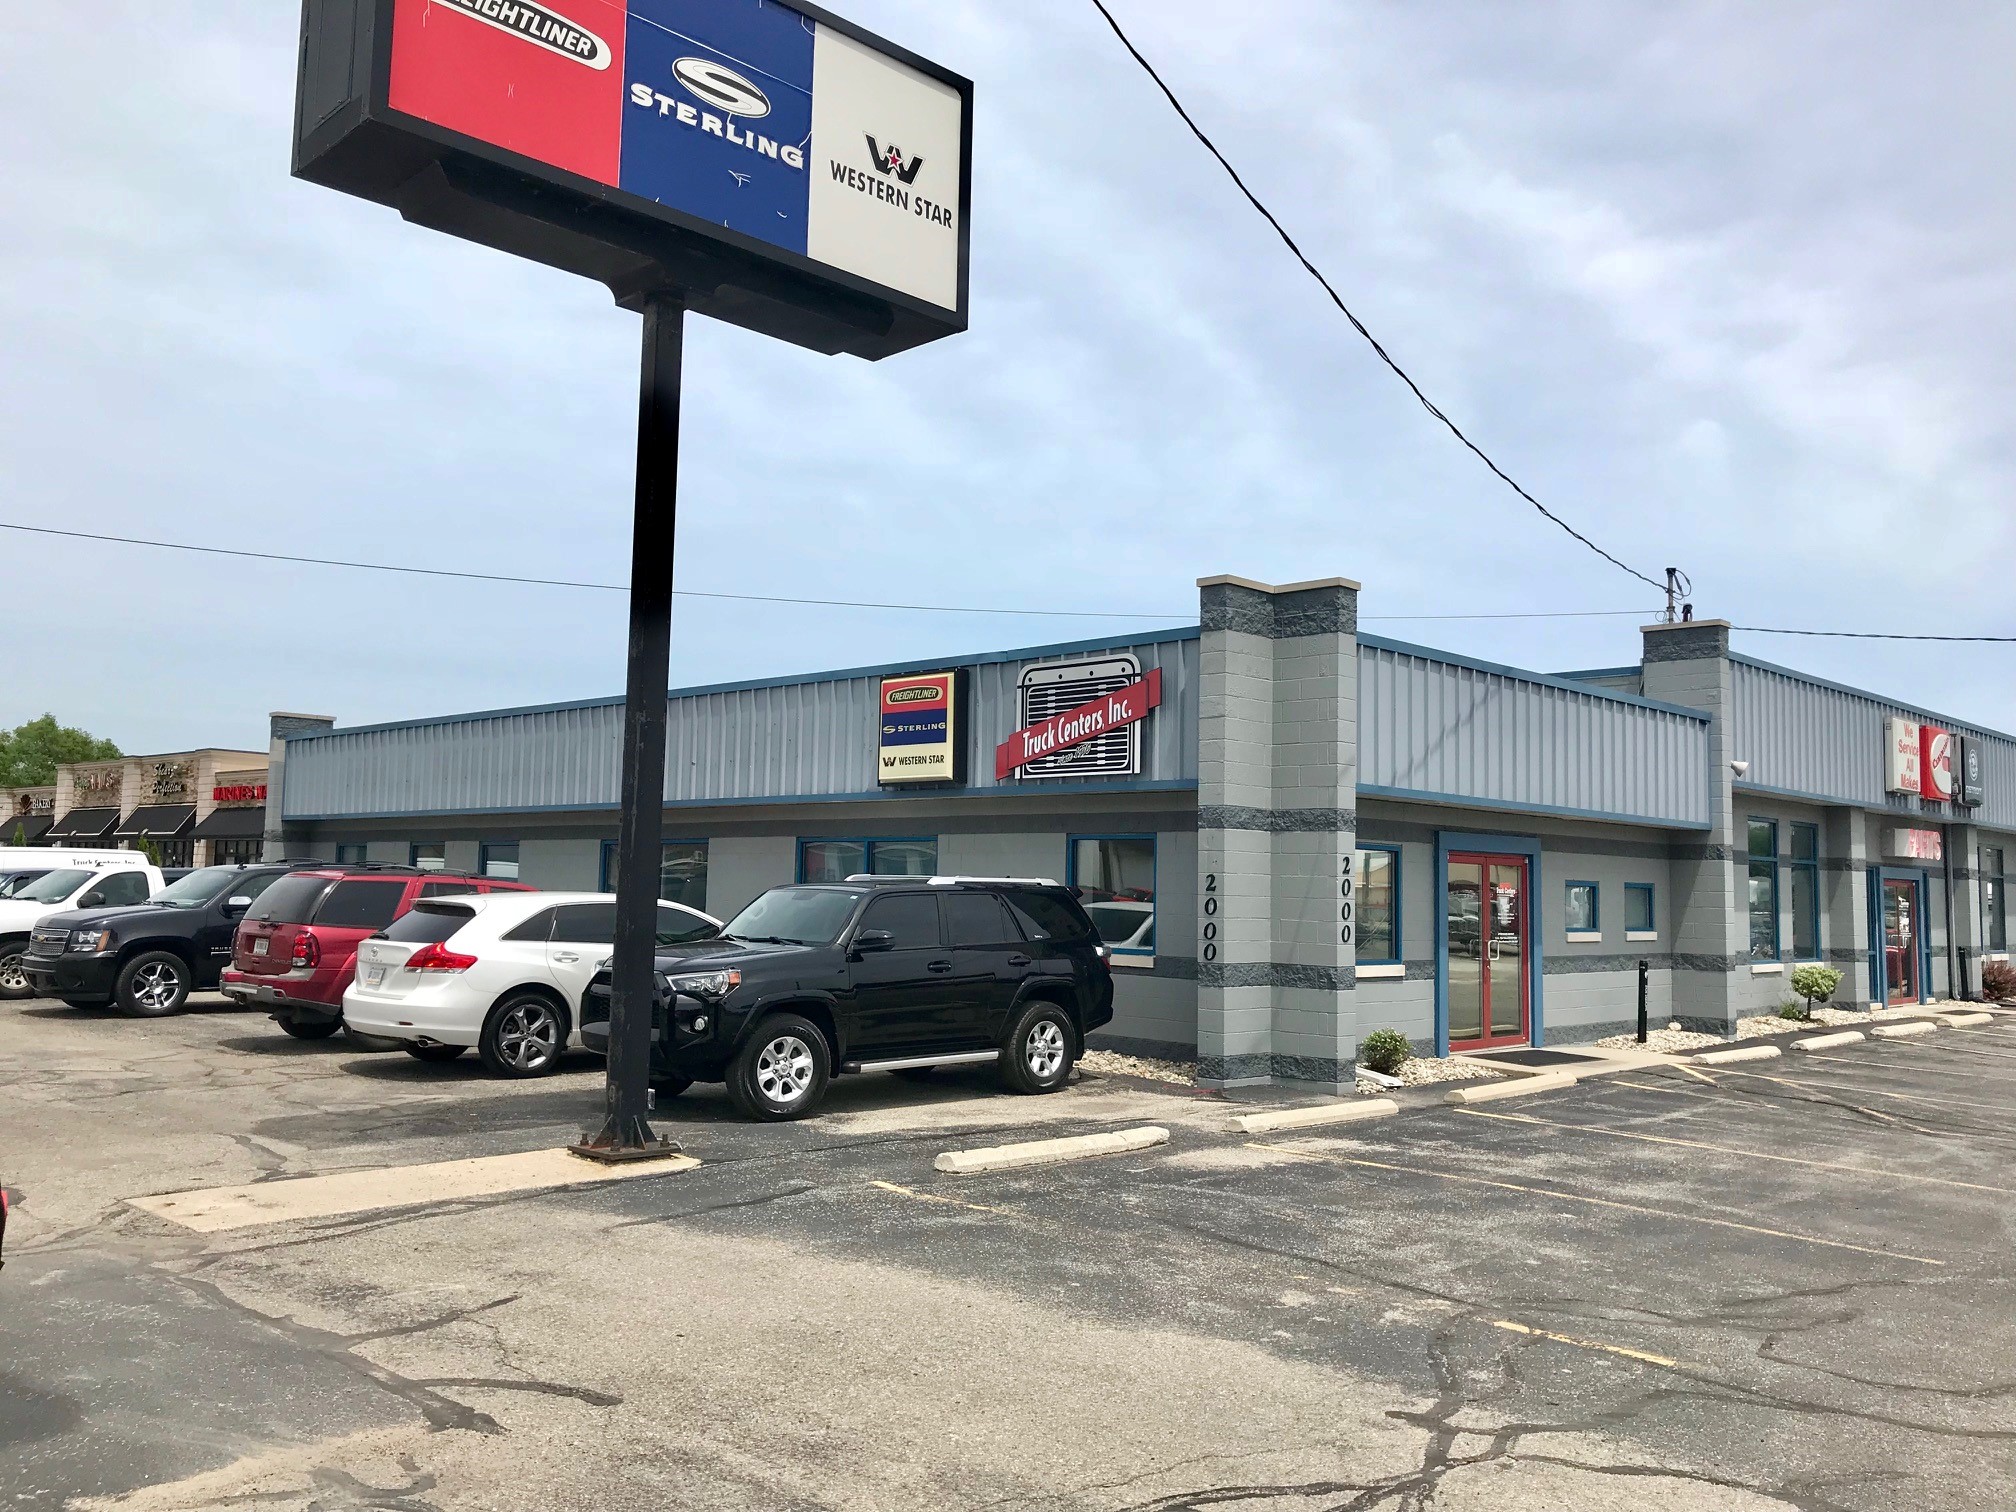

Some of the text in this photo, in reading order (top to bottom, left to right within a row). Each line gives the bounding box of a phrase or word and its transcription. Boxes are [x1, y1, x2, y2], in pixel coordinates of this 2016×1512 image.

[630, 83, 804, 170] STERLING
[830, 159, 953, 230] WESTERN STAR
[891, 689, 937, 701] FREIGHTLINER
[897, 722, 946, 732] STERLING
[1022, 697, 1132, 758] Truck Centers, Inc.
[1903, 722, 1914, 738] We
[1898, 739, 1919, 757] Service
[899, 755, 927, 766] WESTERN
[928, 754, 945, 764] STAR
[1906, 758, 1914, 773] All
[1901, 774, 1919, 791] Makes
[213, 785, 253, 801] MARINES
